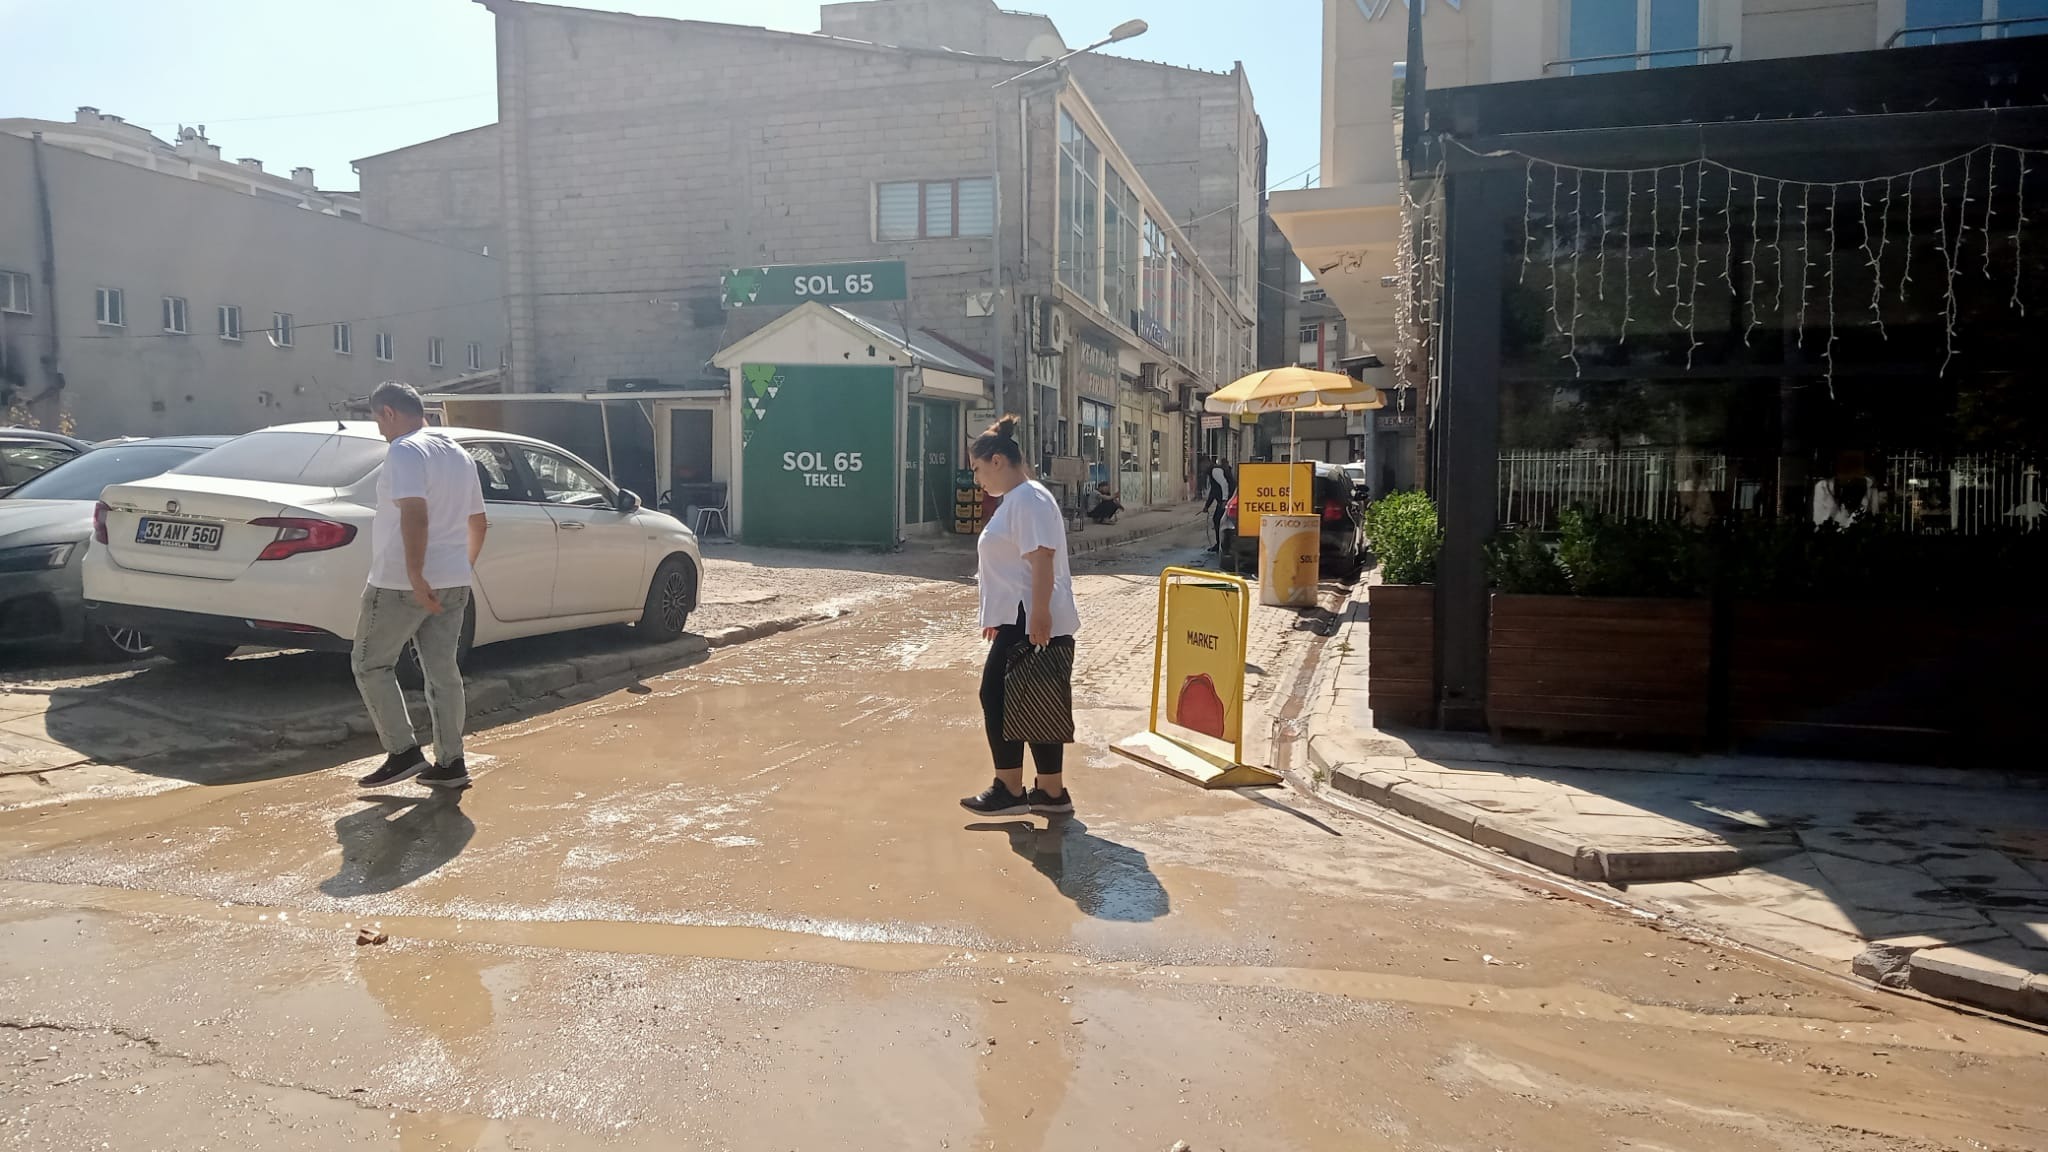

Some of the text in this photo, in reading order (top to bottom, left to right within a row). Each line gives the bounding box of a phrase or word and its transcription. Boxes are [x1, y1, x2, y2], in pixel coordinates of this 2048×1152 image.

[794, 274, 873, 295] SOL 65
[783, 451, 863, 472] SOL 65
[803, 473, 846, 487] TEKEL
[1256, 487, 1277, 498] SOL
[1245, 501, 1277, 512] TEKEL
[146, 522, 218, 544] 33 ANY 560
[1186, 630, 1219, 651] MARKET
